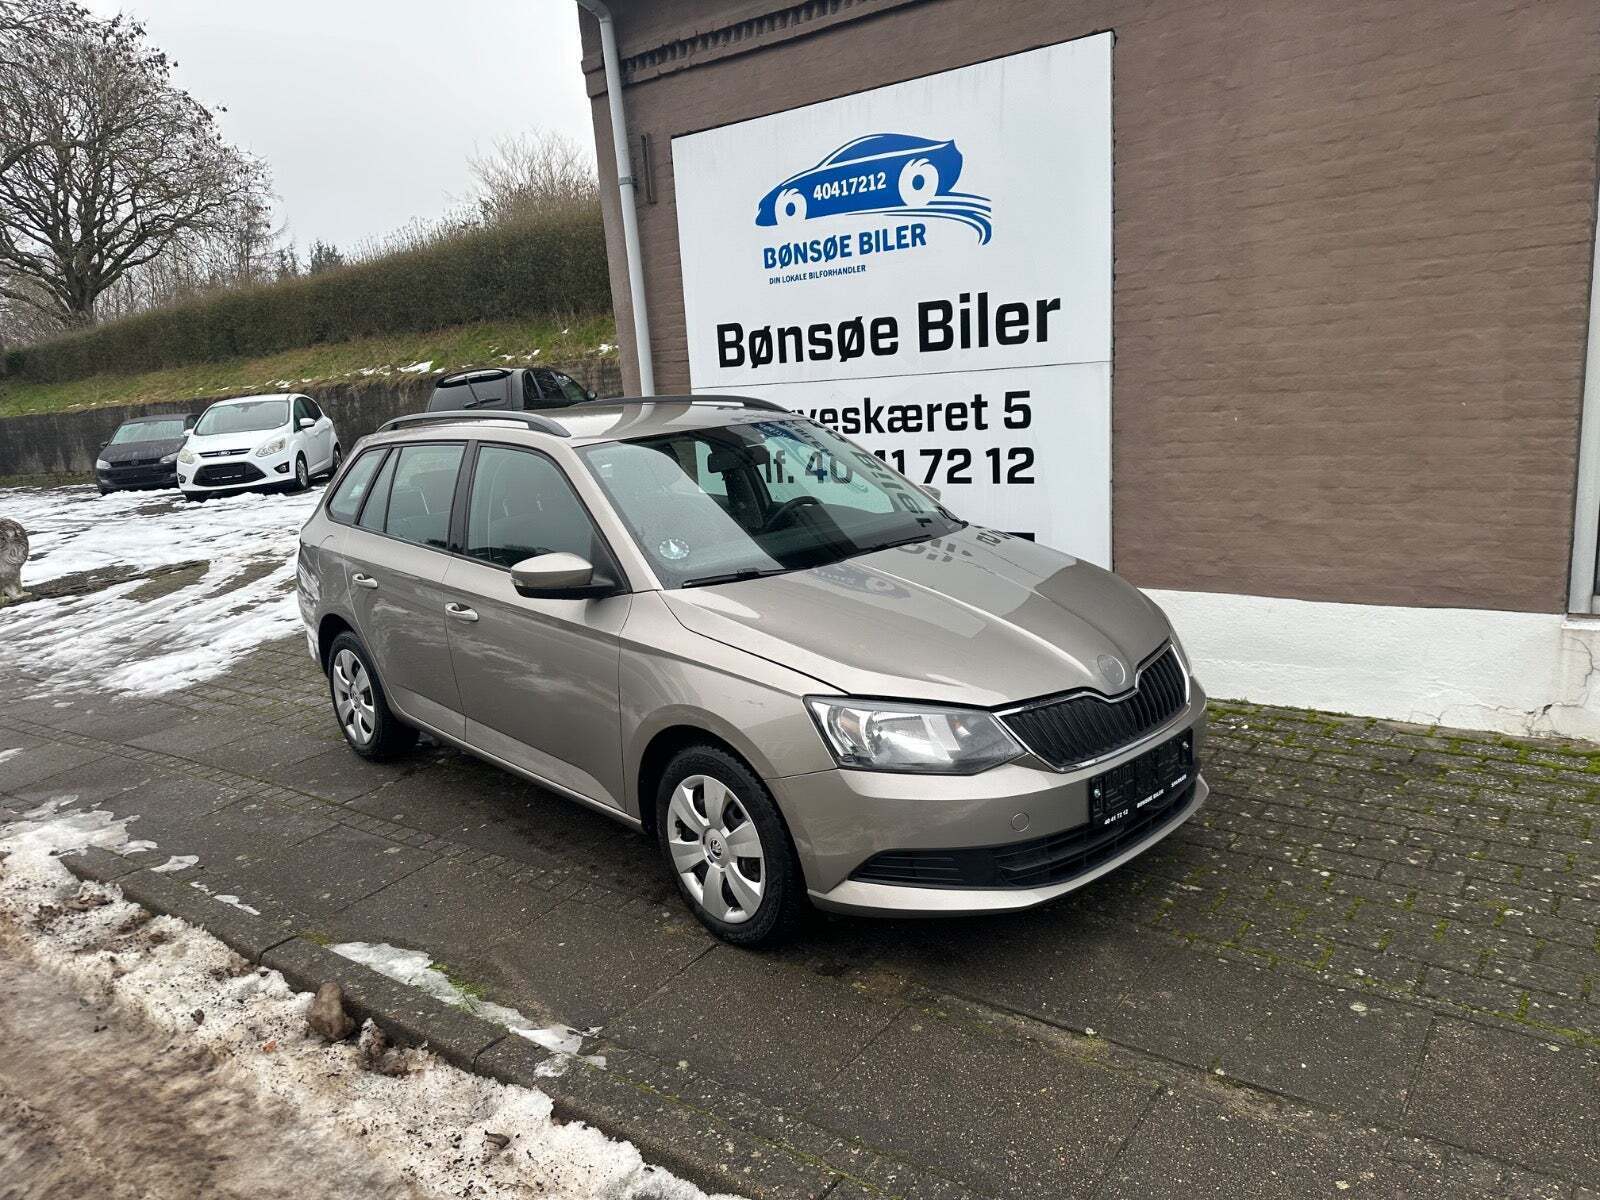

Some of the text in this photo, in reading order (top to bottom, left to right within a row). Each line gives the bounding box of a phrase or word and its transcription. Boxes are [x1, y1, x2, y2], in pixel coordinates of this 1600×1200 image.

[813, 171, 887, 201] 40417212
[763, 223, 927, 270] BØNSØE BILER
[769, 264, 866, 285] DIN LOKALE BILFORHANDLER
[716, 291, 1061, 369] Bønsøe Biler
[1003, 390, 1032, 430] 5
[805, 450, 853, 485] 40
[919, 448, 973, 485] 72
[985, 447, 1035, 485] 12
